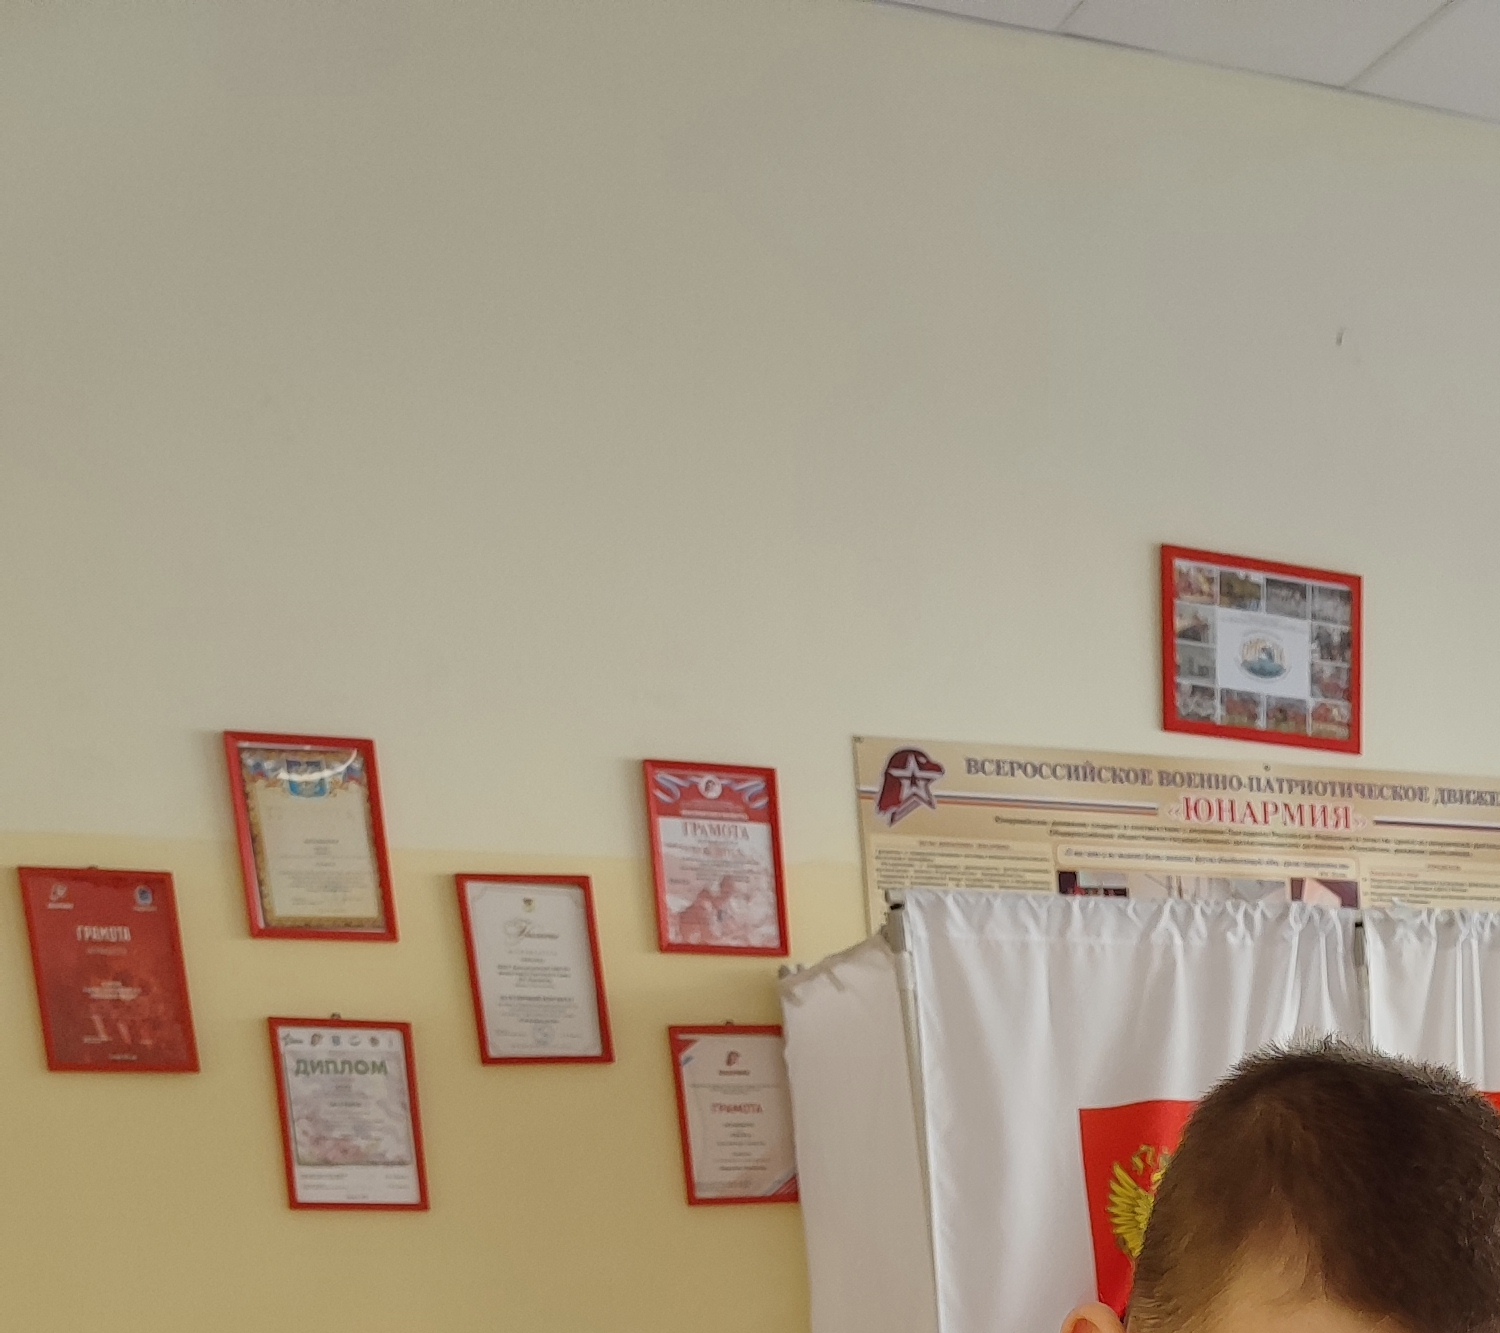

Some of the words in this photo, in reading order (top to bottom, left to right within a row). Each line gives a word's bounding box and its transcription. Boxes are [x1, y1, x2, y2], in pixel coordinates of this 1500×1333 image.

[965, 757, 1154, 786] ВСЕРОССИЙСКОЕ
[1158, 768, 1430, 804] ВОЕННО-ПАТРИОТИЧЕСКОЕ
[1167, 797, 1367, 830] «ЮНАРМИЯ»
[682, 822, 749, 839] ГРАМОТА
[76, 925, 131, 942] ГРАМОТА
[294, 1059, 388, 1076] ДИПЛОМ
[711, 1103, 763, 1115] ГРАМОТА
